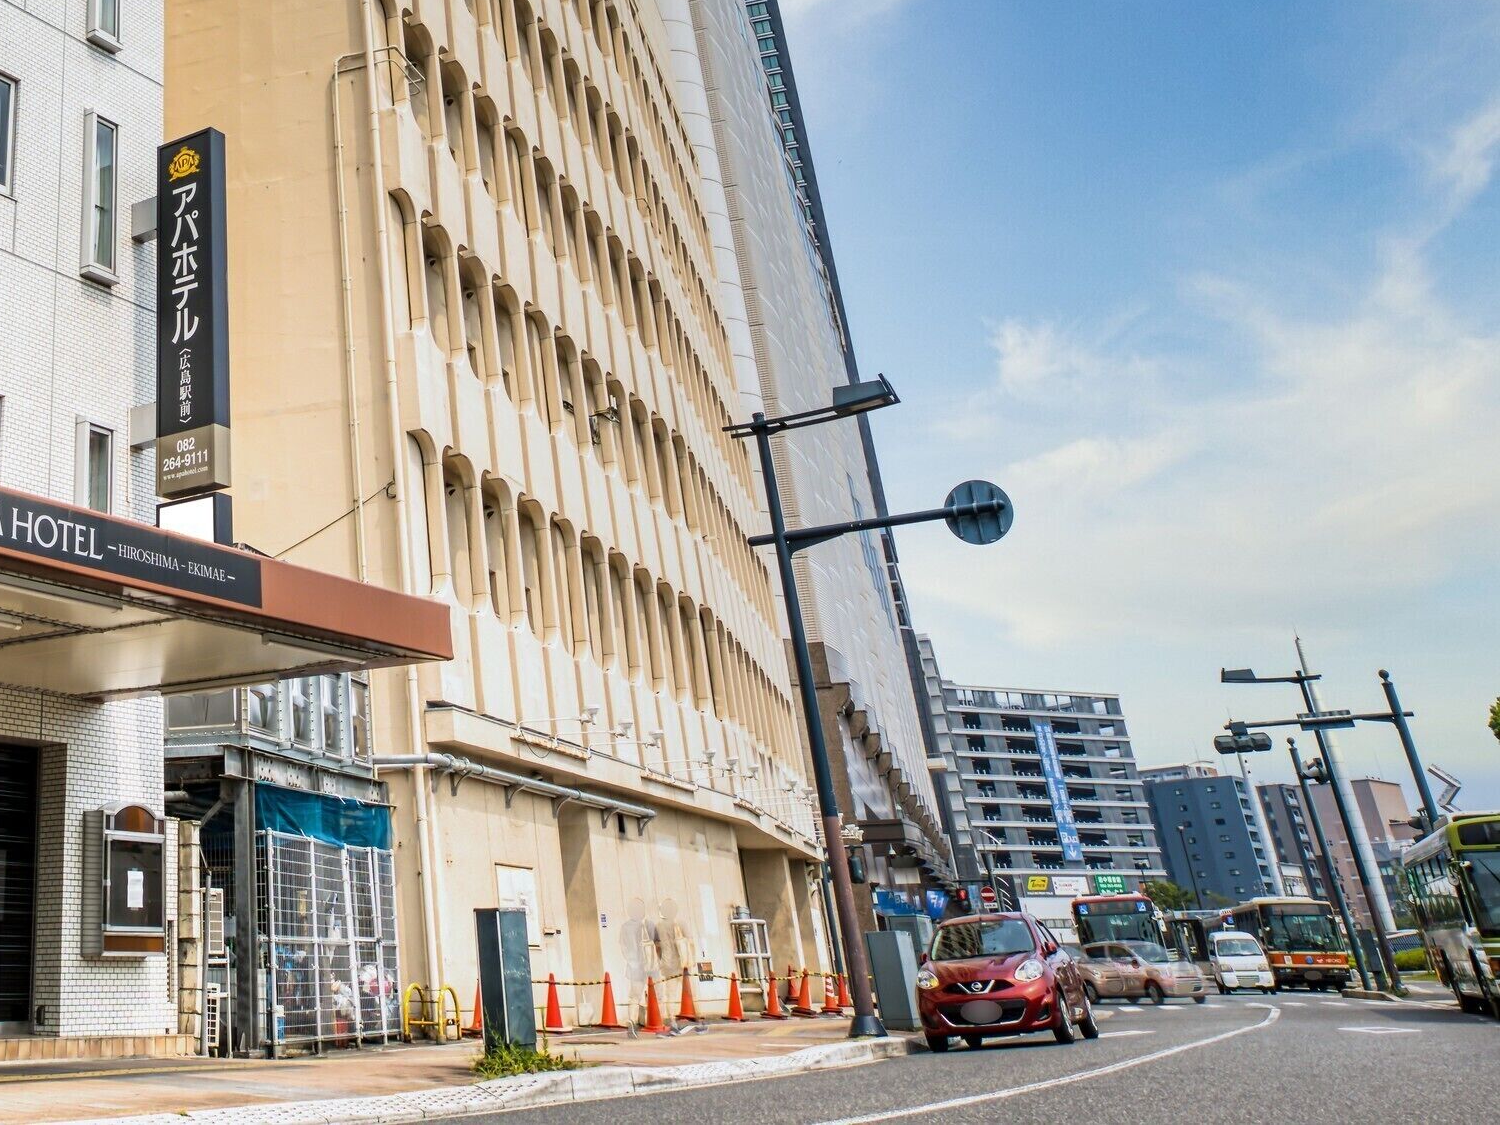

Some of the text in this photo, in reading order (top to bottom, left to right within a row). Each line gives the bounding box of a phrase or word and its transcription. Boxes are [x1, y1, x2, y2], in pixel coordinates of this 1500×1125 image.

[171, 183, 199, 344] アパホテル
[176, 437, 195, 452] 082
[162, 449, 208, 472] 264-9111
[163, 465, 208, 481] www.apahotel.com
[12, 507, 103, 561] HOTEL
